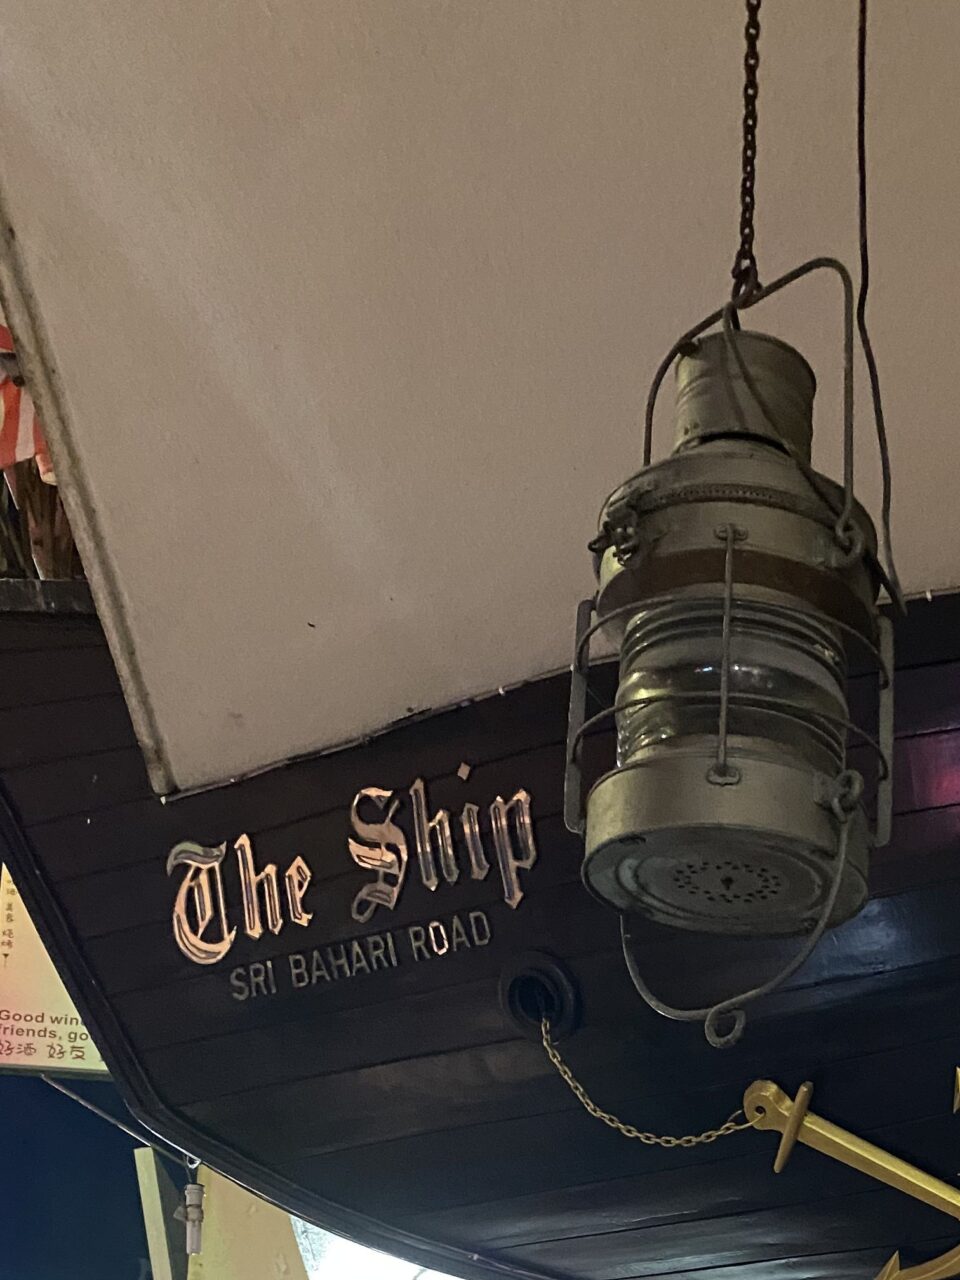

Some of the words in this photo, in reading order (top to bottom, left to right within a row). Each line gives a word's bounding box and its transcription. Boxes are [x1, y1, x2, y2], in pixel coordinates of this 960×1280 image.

[166, 833, 314, 965] The
[348, 762, 537, 924] Ship
[229, 960, 277, 1001] SRI
[288, 932, 398, 988] BAHARI
[408, 911, 492, 962] ROAD
[0, 1009, 45, 1023] Good
